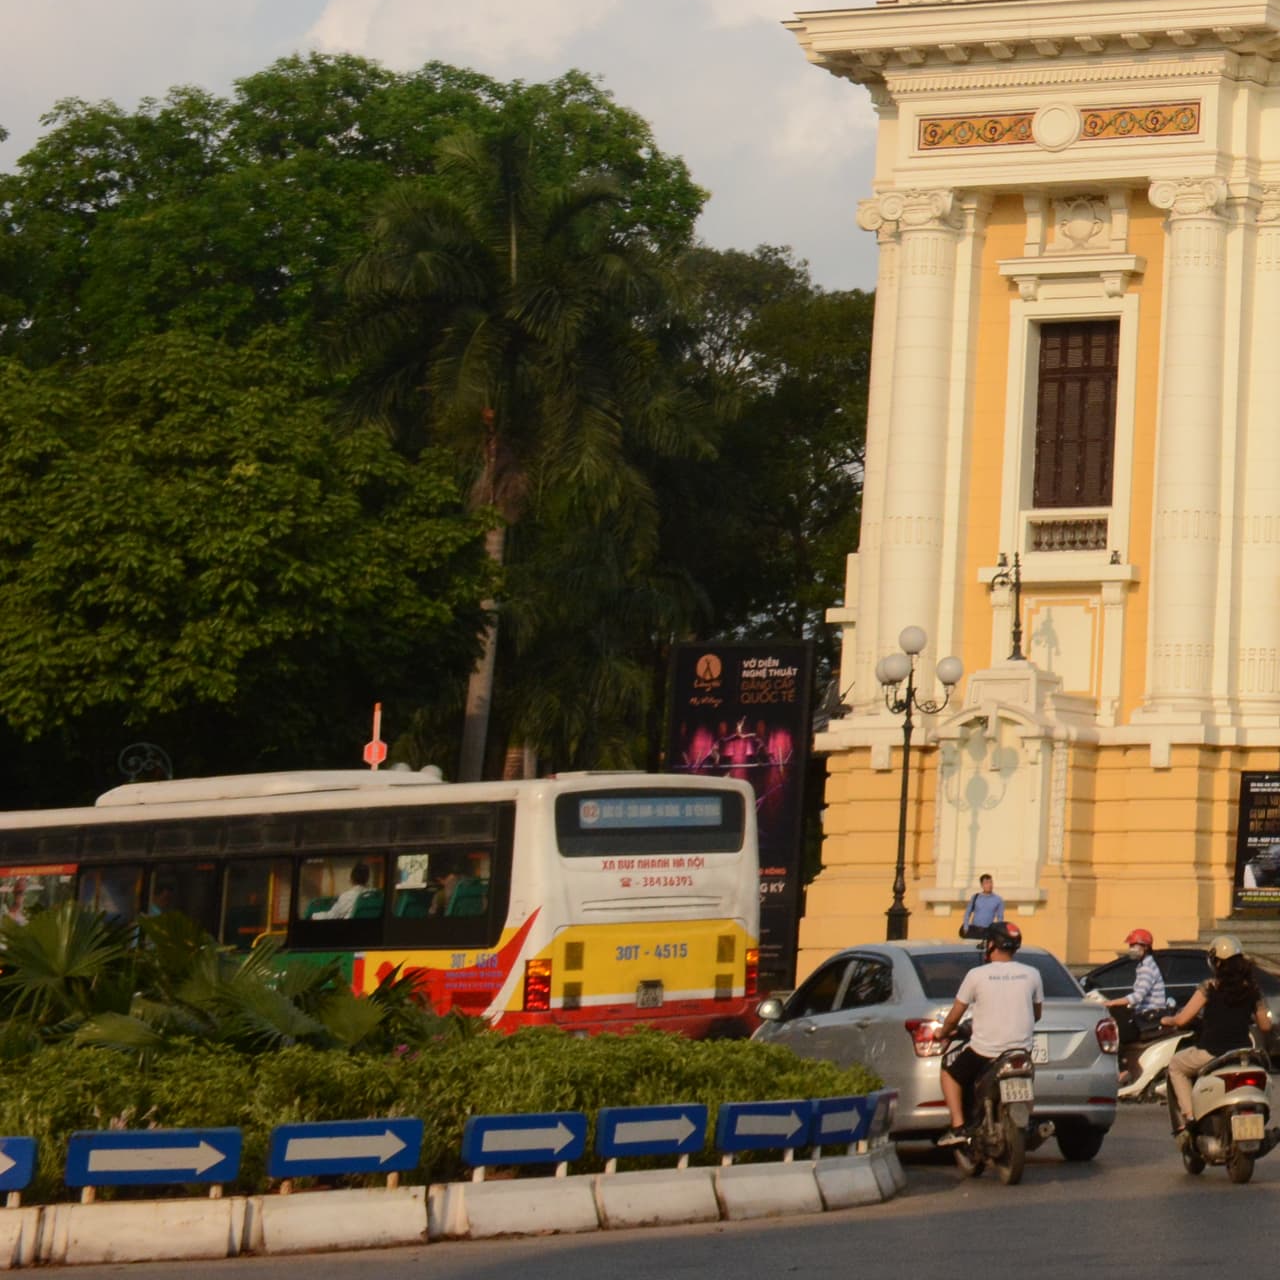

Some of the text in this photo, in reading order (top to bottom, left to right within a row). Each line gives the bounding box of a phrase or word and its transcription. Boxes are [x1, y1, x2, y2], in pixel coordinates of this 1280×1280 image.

[618, 858, 634, 870] BUS
[637, 857, 669, 869] NHANH
[616, 945, 641, 961] 30T
[654, 943, 688, 959] 4515
